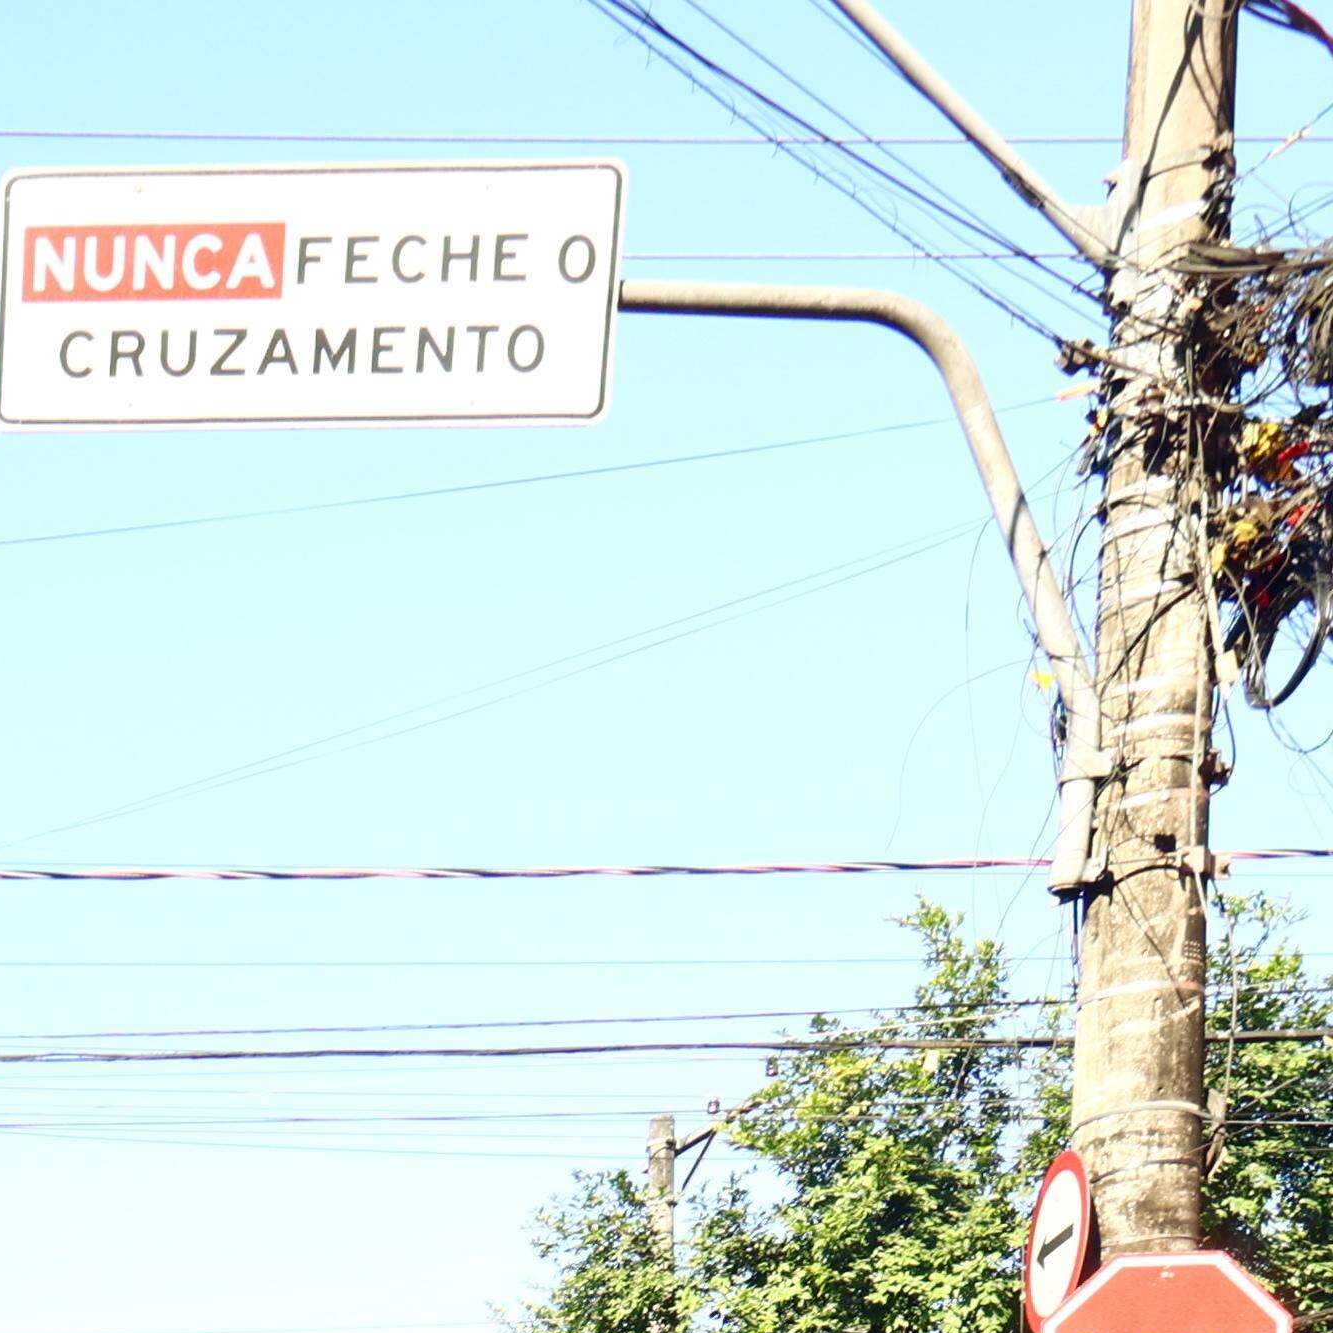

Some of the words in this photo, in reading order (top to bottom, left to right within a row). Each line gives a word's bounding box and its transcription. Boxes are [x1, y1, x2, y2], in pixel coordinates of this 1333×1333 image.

[33, 231, 276, 292] NUNCA
[296, 233, 529, 285] FECHE
[558, 234, 596, 284] O
[59, 325, 545, 379] CRUZAMENTO
